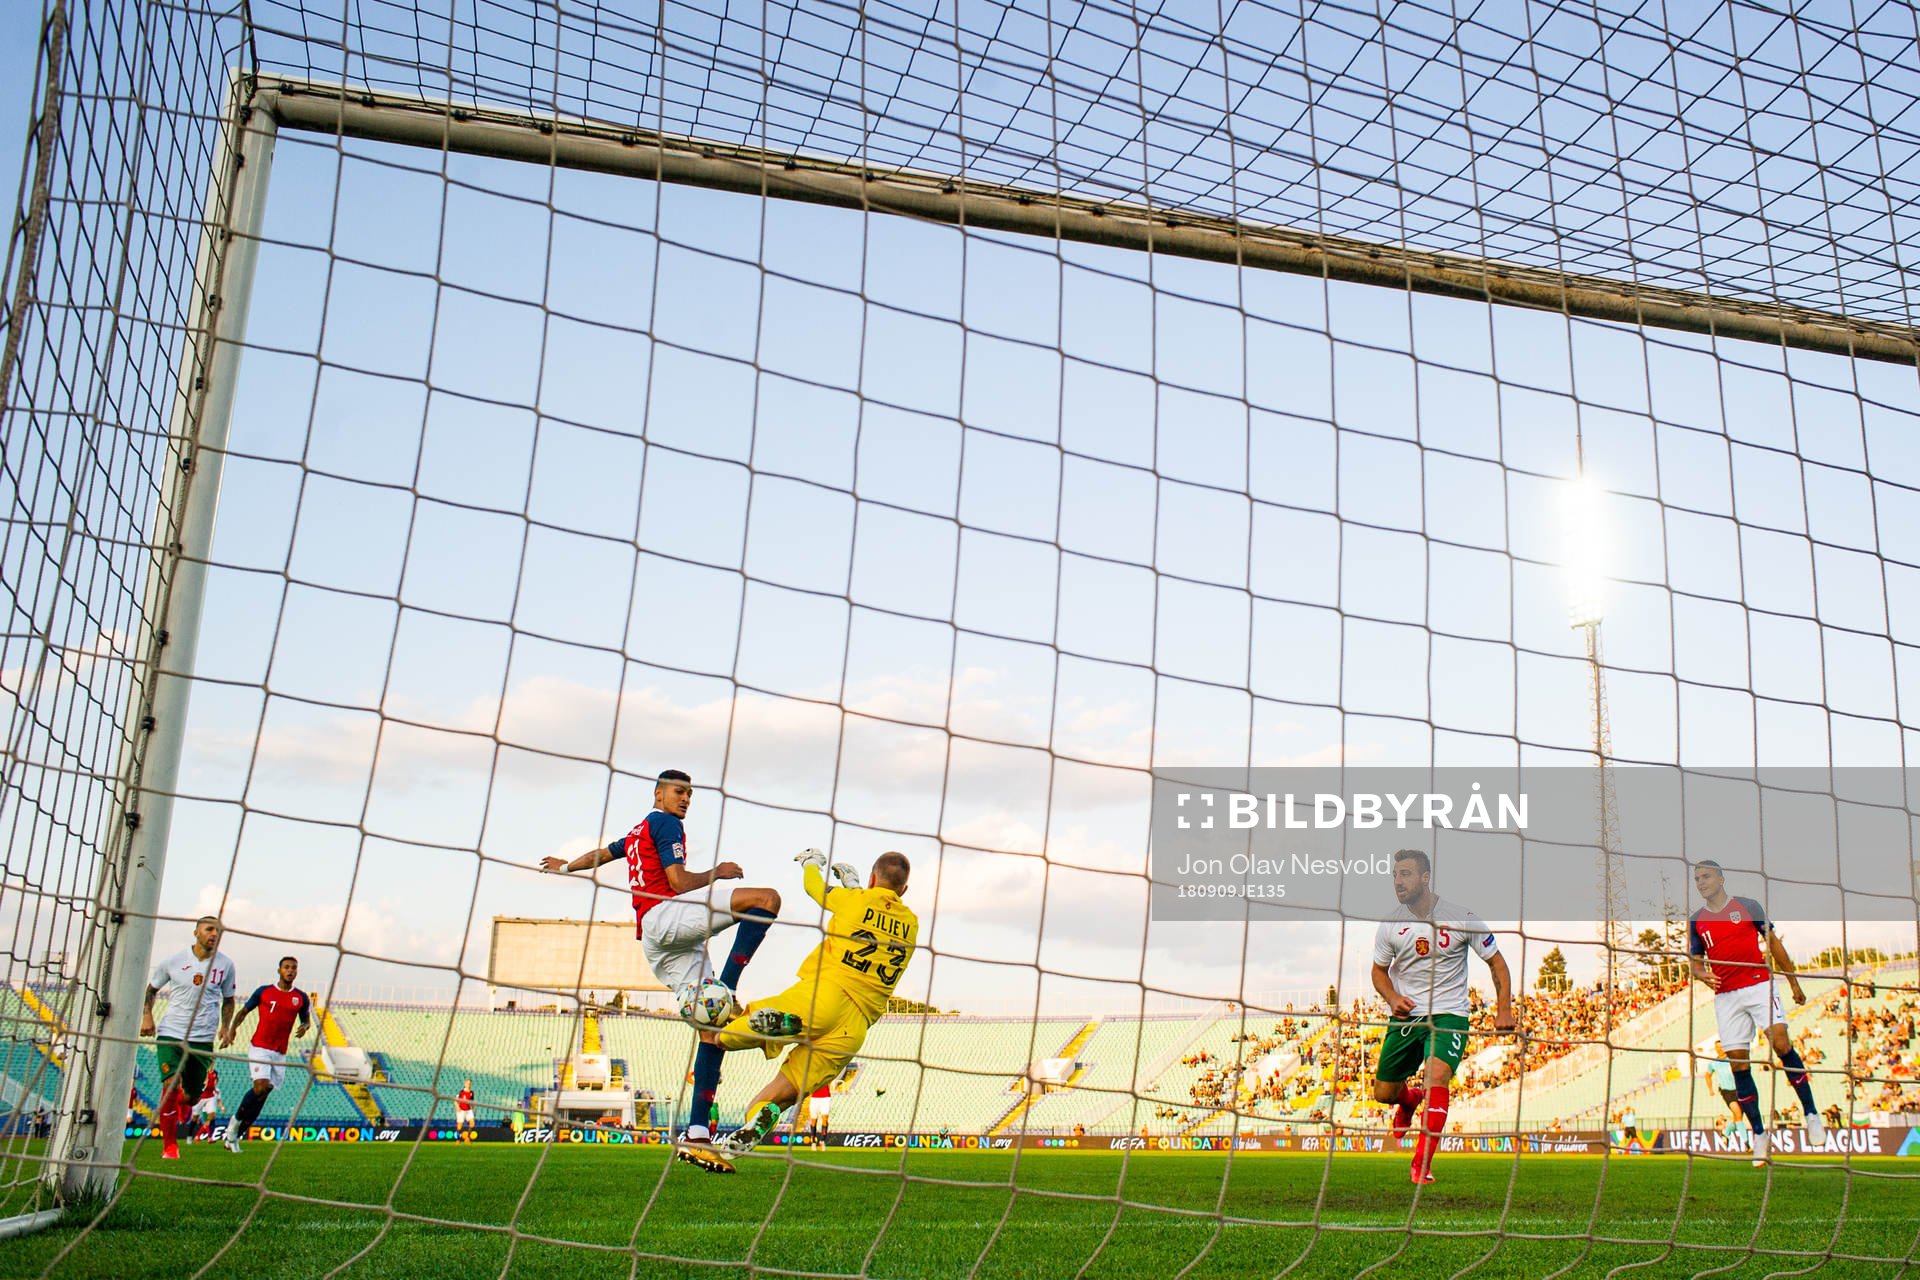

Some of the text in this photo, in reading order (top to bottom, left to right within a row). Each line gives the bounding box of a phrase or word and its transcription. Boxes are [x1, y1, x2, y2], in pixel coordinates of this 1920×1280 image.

[862, 907, 910, 939] P.ILIEV
[1438, 925, 1450, 949] 5
[1701, 930, 1714, 948] 11
[841, 928, 906, 986] 23
[210, 968, 225, 986] 11
[269, 1000, 277, 1013] 7
[843, 1134, 882, 1148] UEFA
[1110, 1137, 1146, 1150] UEFA
[1148, 1136, 1239, 1151] FOUNDATION
[1302, 1136, 1319, 1151] UEFA
[1440, 1137, 1464, 1152] UEFA
[1465, 1134, 1539, 1152] FOUNDATON
[1540, 1134, 1552, 1154] for
[1713, 1129, 1796, 1153] NATINS
[1799, 1129, 1882, 1153] LAGUE
